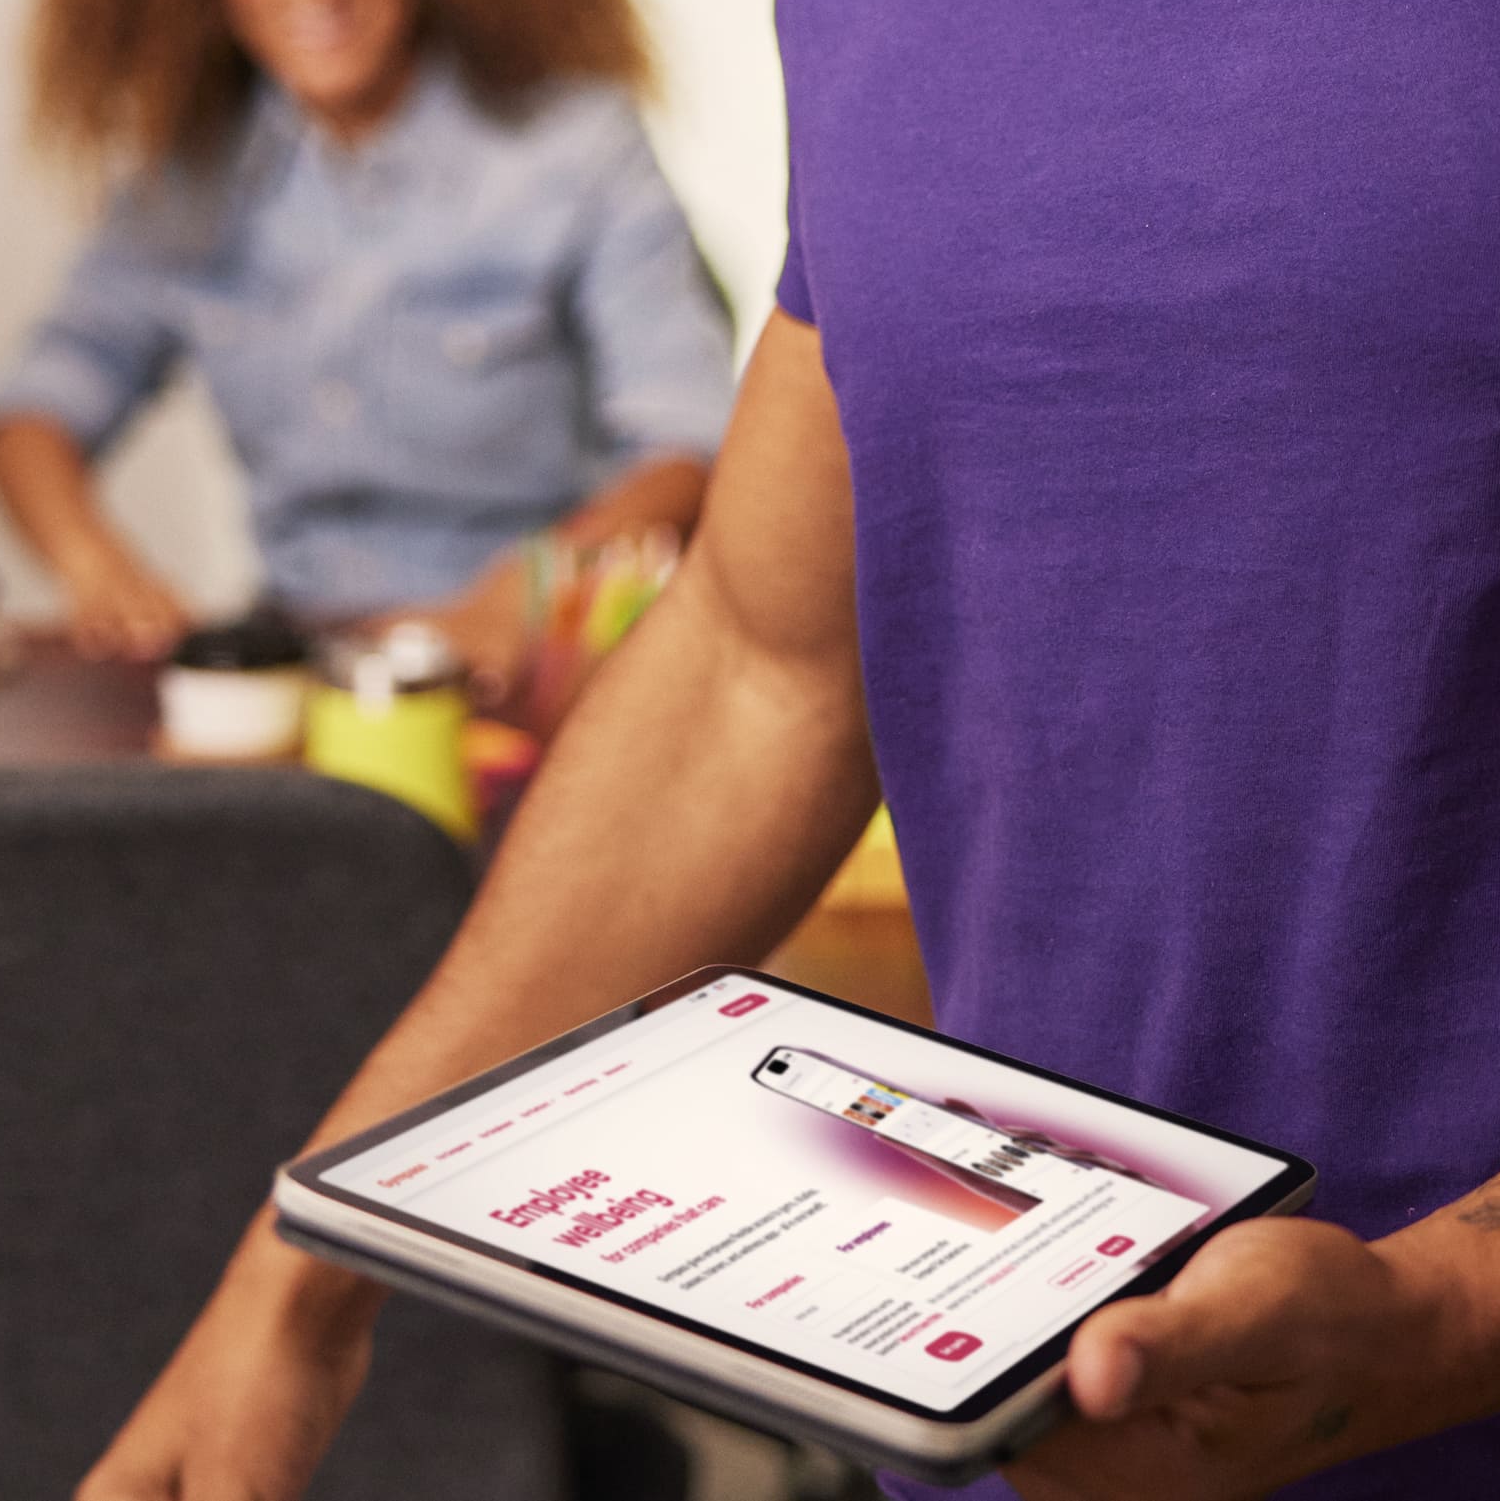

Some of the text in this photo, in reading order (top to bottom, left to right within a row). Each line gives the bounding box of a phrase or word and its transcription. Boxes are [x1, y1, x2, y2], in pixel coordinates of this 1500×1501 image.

[489, 1170, 611, 1228] Employee
[554, 1189, 674, 1247] wellbeing
[600, 1196, 725, 1263] for companies that care
[836, 1242, 858, 1252] For
[746, 1298, 766, 1309] For
